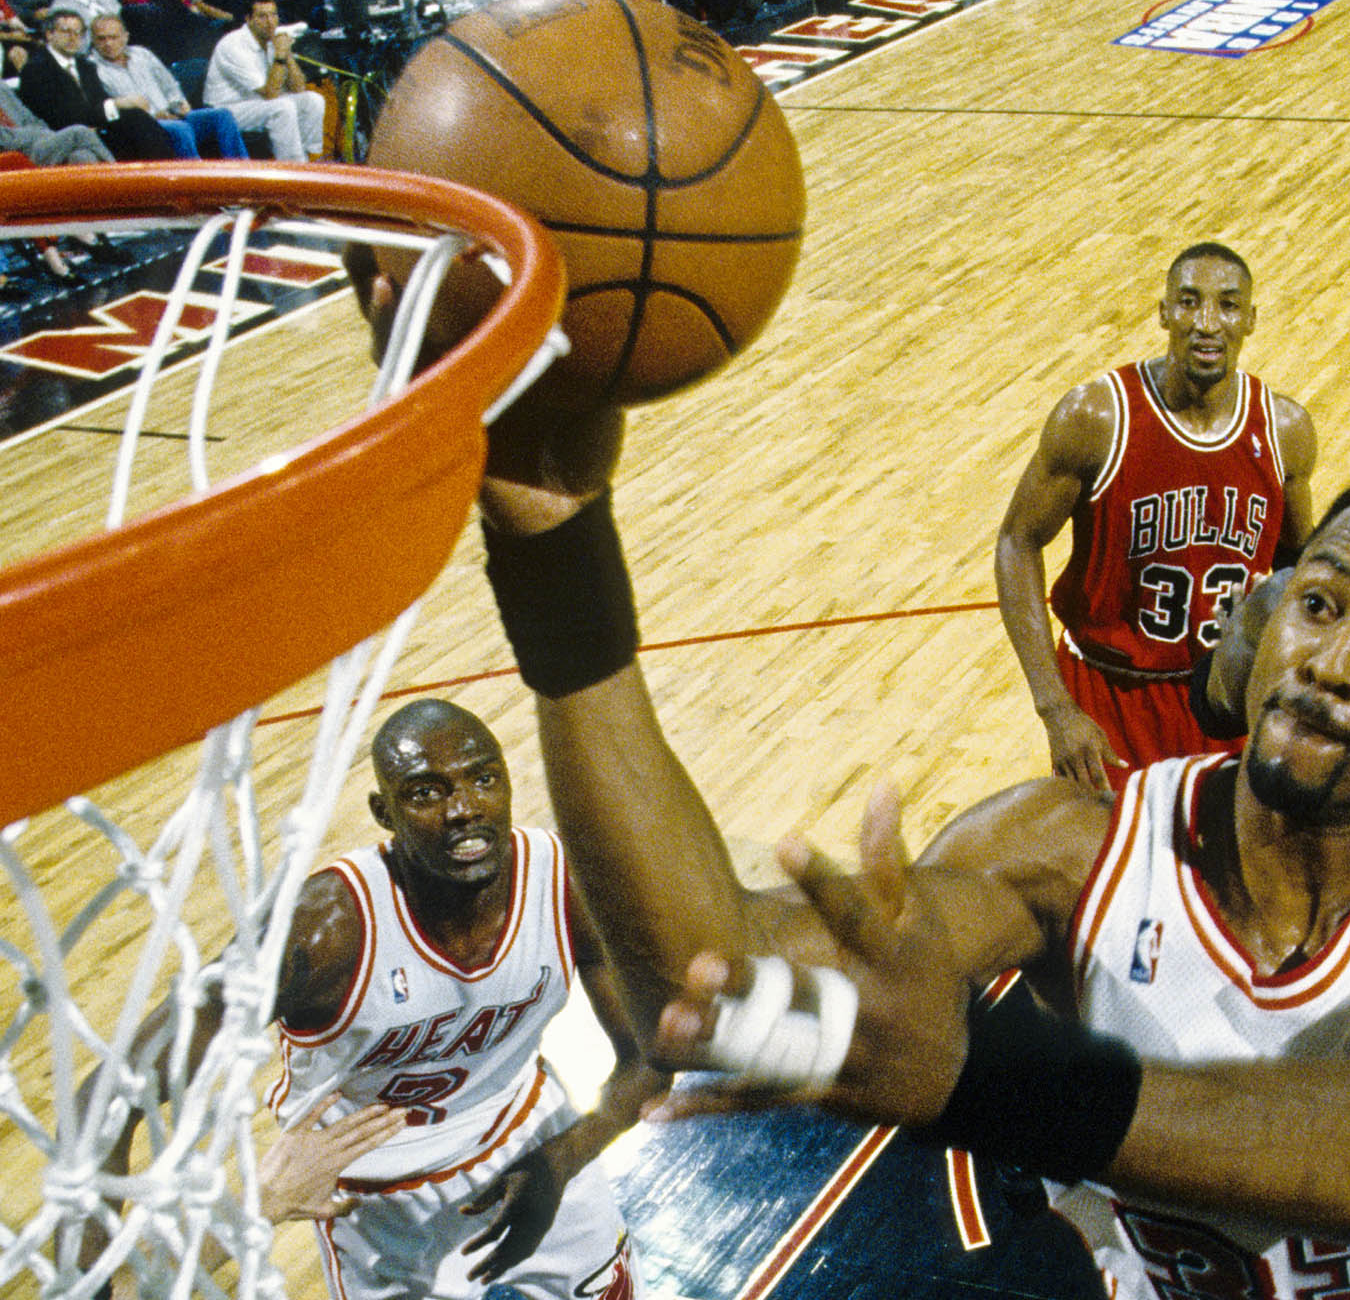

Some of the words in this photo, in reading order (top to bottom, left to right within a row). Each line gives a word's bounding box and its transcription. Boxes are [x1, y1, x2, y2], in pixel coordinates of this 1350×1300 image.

[1128, 485, 1268, 560] BULLS
[1138, 562, 1250, 649] 33
[351, 965, 552, 1072] HEAT
